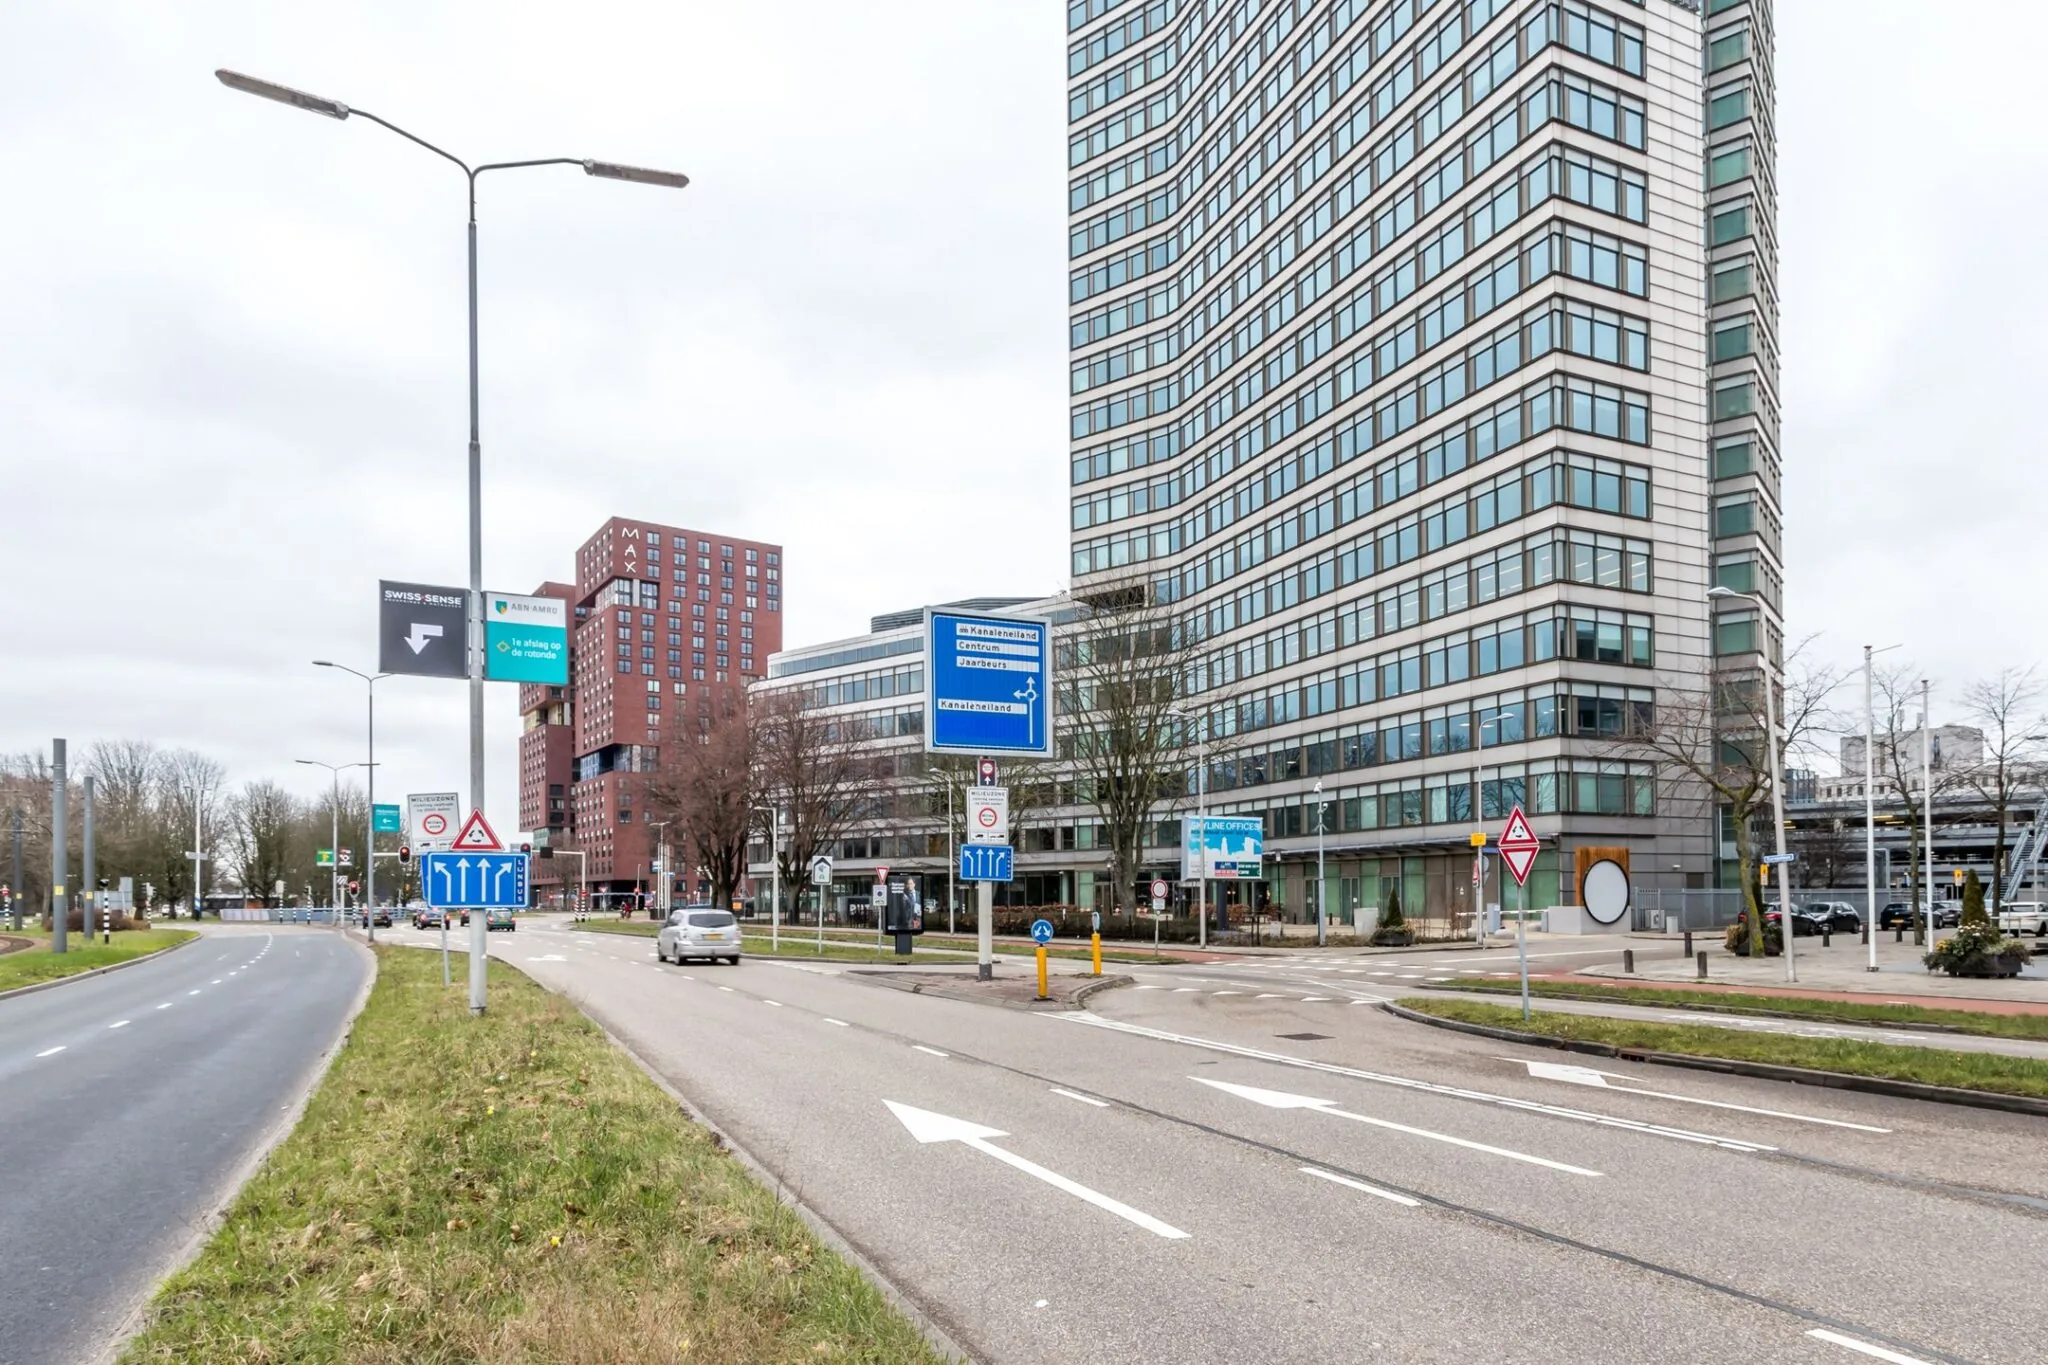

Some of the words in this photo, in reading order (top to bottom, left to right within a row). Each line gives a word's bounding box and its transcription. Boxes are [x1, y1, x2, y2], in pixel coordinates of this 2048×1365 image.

[622, 527, 639, 573] MAX
[970, 624, 1037, 640] Kanaleneiland
[512, 637, 521, 646] 1e
[523, 639, 549, 651] afslag
[550, 642, 562, 651] op
[958, 641, 1000, 652] Centrum
[511, 648, 522, 657] de
[524, 650, 557, 660] rotonde
[958, 658, 1007, 669] Jaarbeurs
[940, 700, 1012, 712] Kanaleneiland
[1226, 822, 1260, 830] OFFICES
